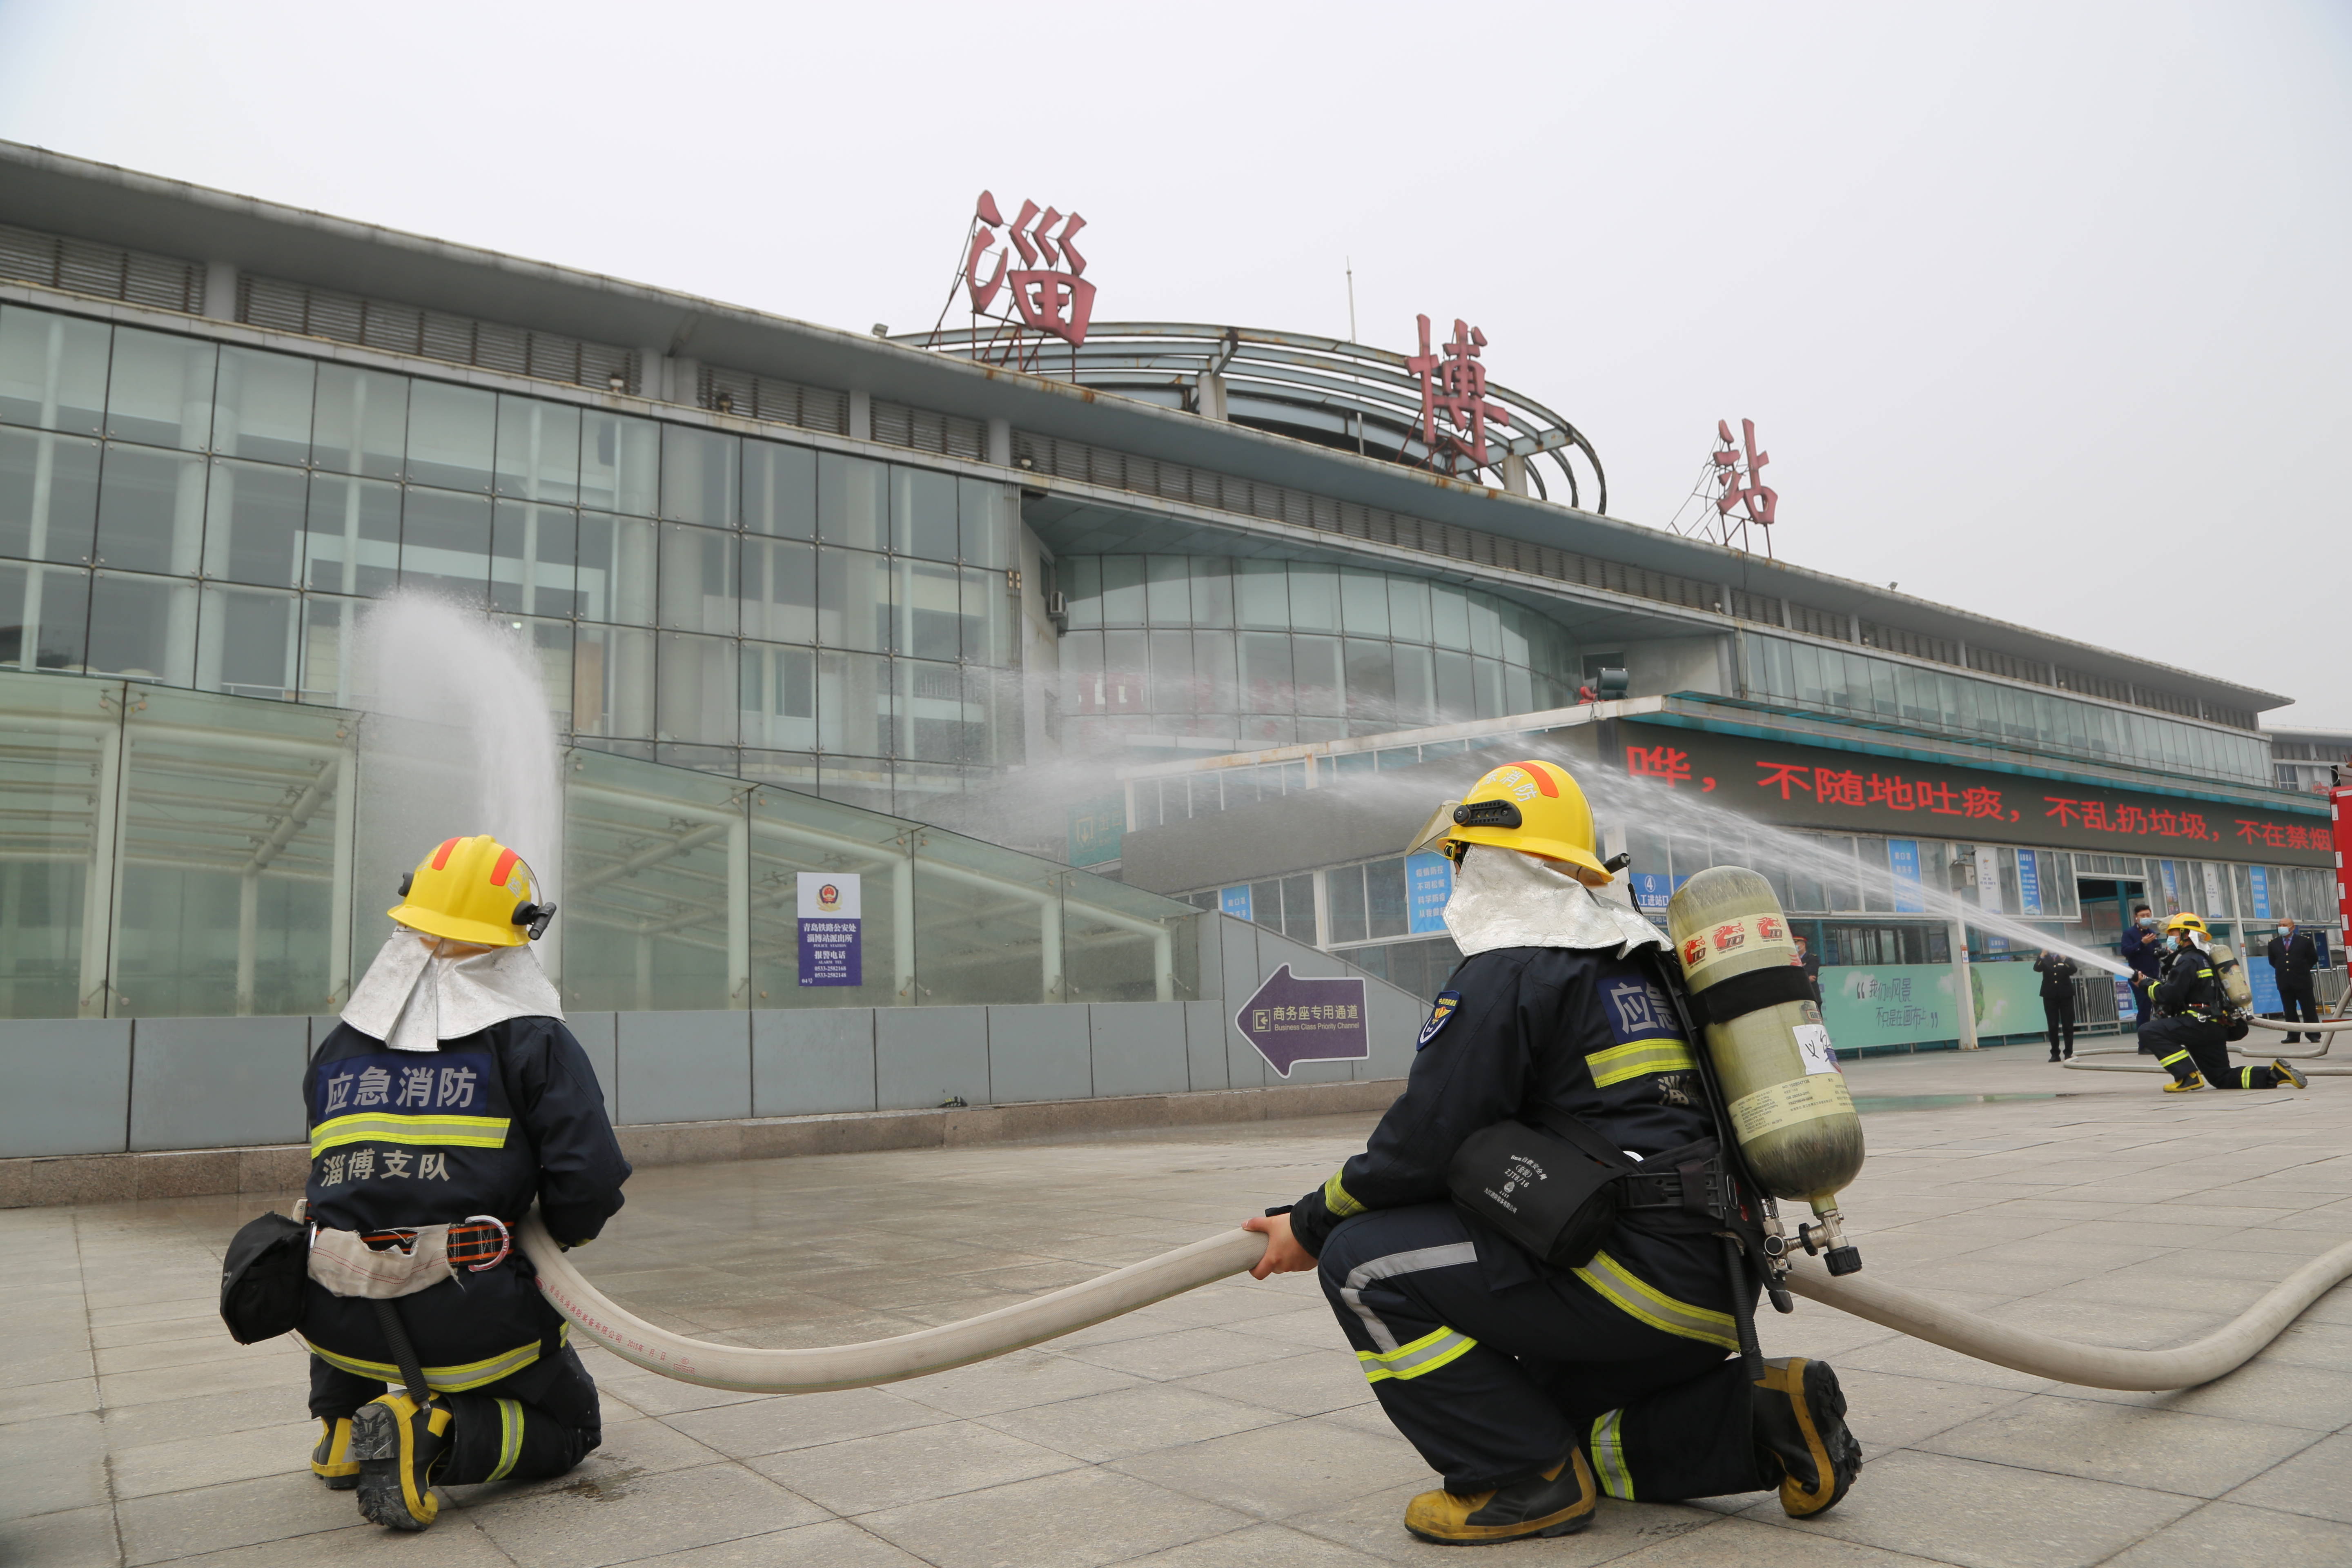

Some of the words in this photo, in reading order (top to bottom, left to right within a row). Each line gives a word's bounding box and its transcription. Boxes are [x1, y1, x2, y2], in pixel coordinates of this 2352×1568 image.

[804, 923, 856, 932] 青岛铁路公安处
[807, 934, 853, 943] 淄博站派出所
[814, 951, 846, 959] 报警电话
[1273, 1004, 1358, 1020] 商务座专用通道
[1318, 1022, 1336, 1031] Priority
[325, 1066, 477, 1115] 应急消防
[321, 1149, 450, 1187] 淄博支队
